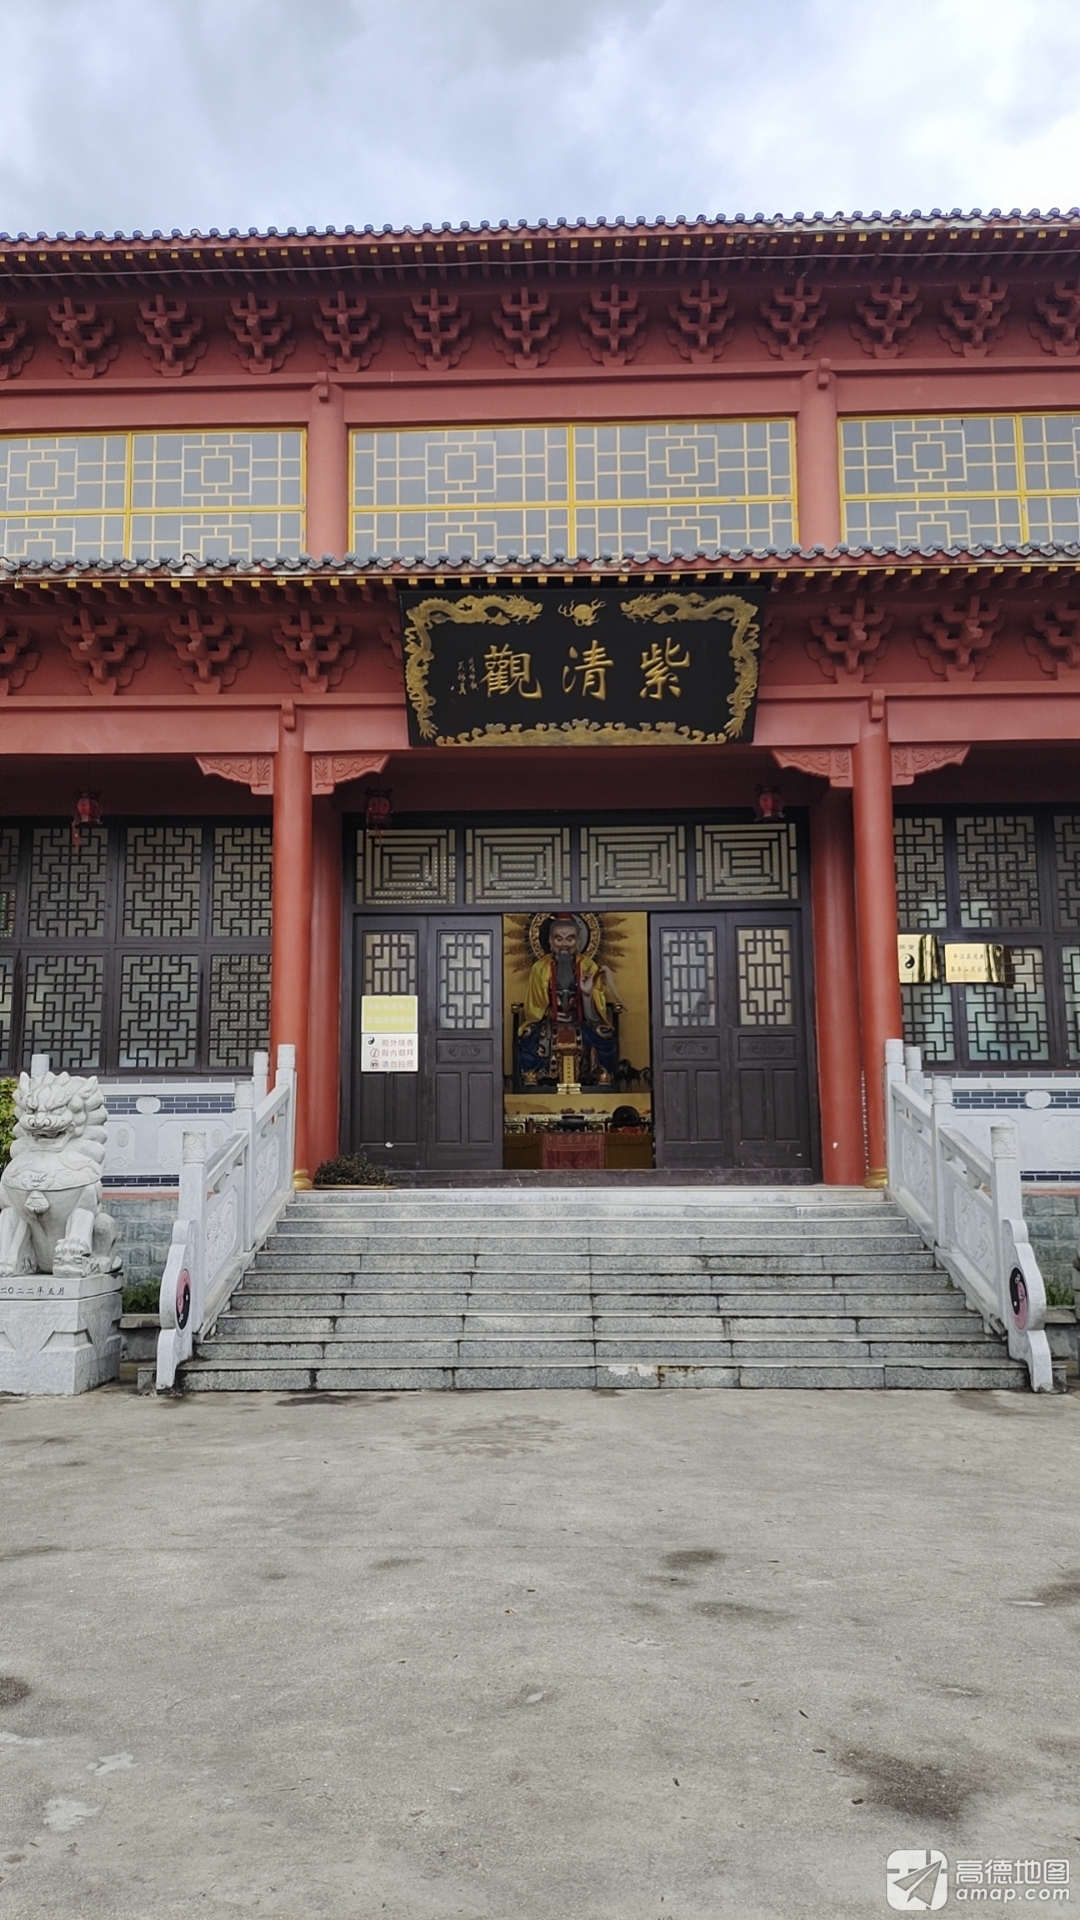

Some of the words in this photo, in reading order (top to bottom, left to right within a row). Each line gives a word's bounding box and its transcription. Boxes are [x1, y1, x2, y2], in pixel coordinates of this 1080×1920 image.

[480, 637, 690, 701] 紫清觀
[381, 1039, 414, 1047] 殿外烧香
[381, 1060, 414, 1068] 请勿拍照
